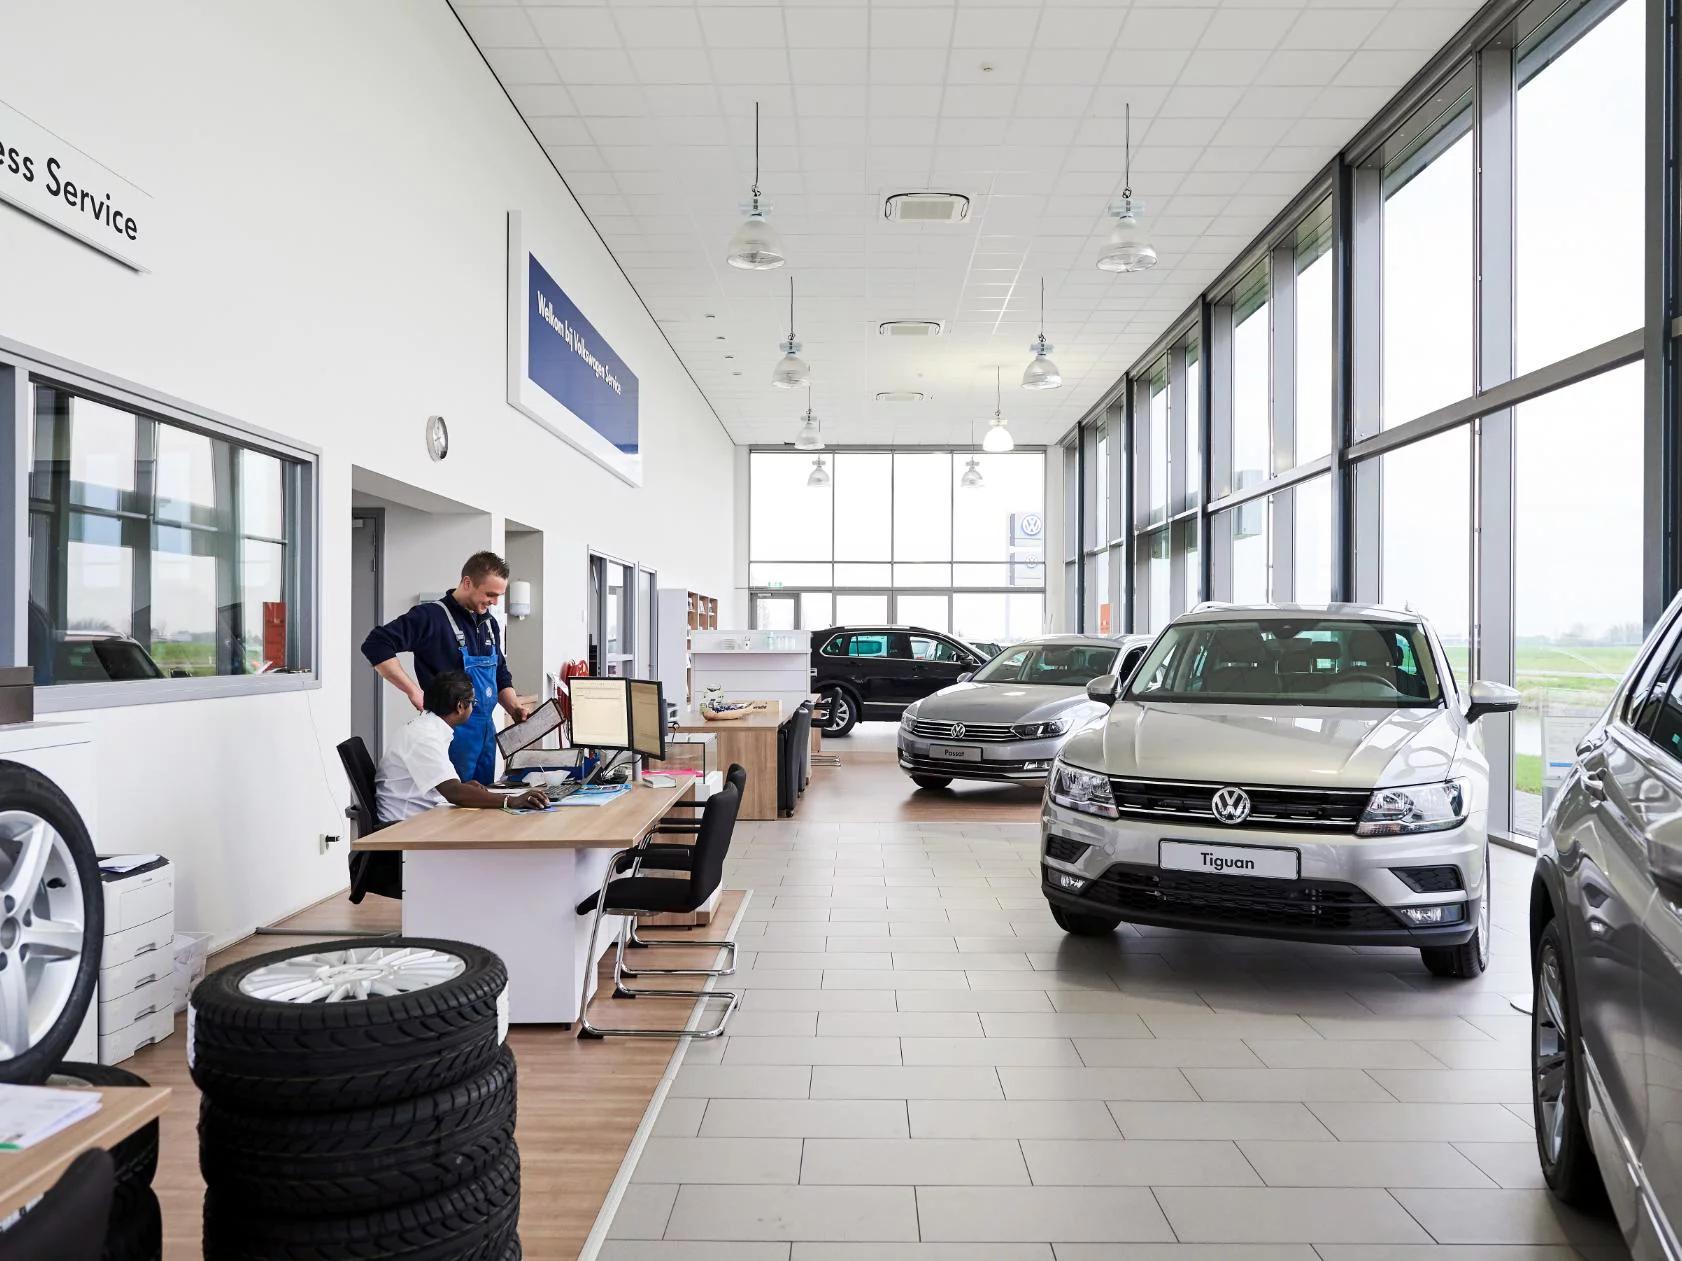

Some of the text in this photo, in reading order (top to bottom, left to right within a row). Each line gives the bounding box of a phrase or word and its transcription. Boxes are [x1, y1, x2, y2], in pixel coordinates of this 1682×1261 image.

[45, 157, 138, 240] Service
[537, 290, 565, 338] Welkom
[565, 320, 573, 352] bij
[573, 330, 605, 379] Volkswagen
[944, 749, 965, 758] Passat
[1211, 786, 1250, 824] VW
[1200, 852, 1255, 871] Tiguan
